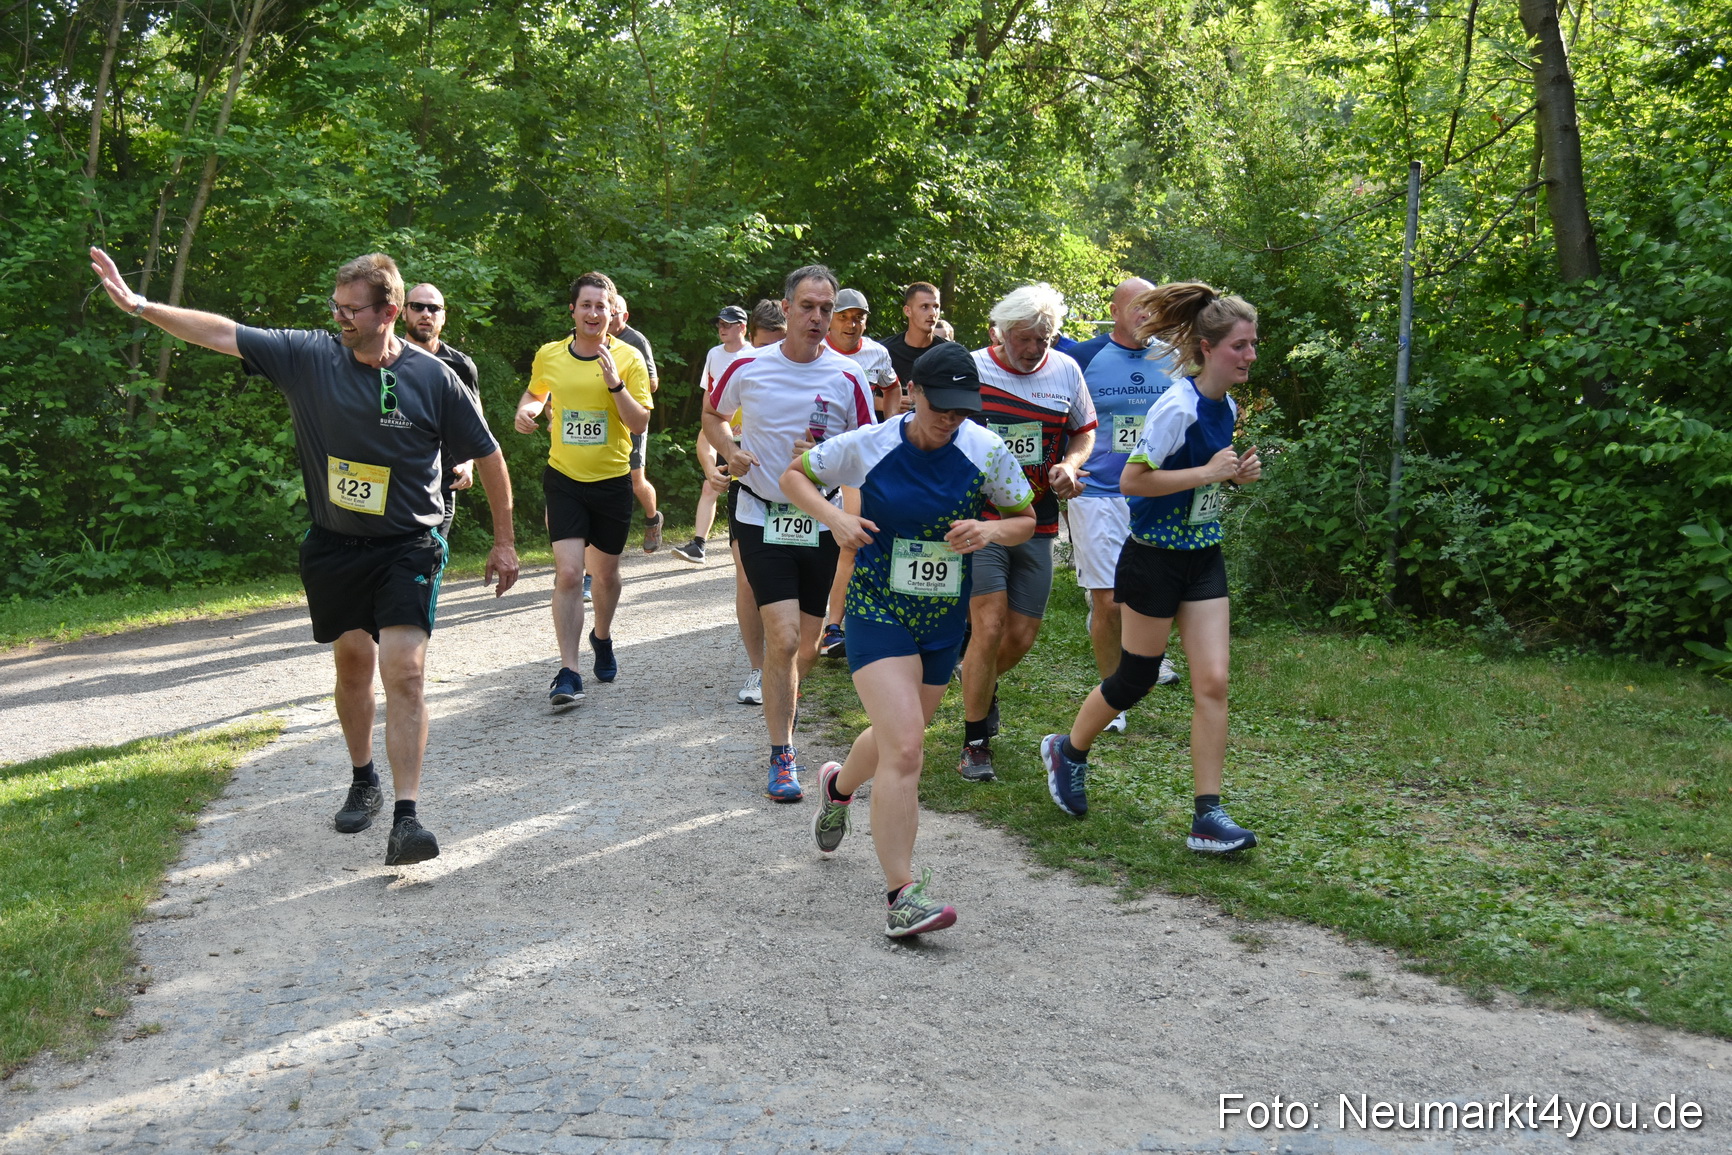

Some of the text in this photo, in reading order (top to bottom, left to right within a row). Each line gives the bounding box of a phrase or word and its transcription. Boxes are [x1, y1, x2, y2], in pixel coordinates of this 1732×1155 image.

[1031, 392, 1067, 401] NEUMARKT
[1098, 386, 1171, 397] SCHABMÜLLE
[380, 418, 412, 427] BURKHARDT
[566, 422, 602, 436] 2186
[1118, 428, 1142, 443] 21
[337, 477, 371, 499] 423
[772, 517, 813, 535] 1790
[908, 560, 948, 582] 199
